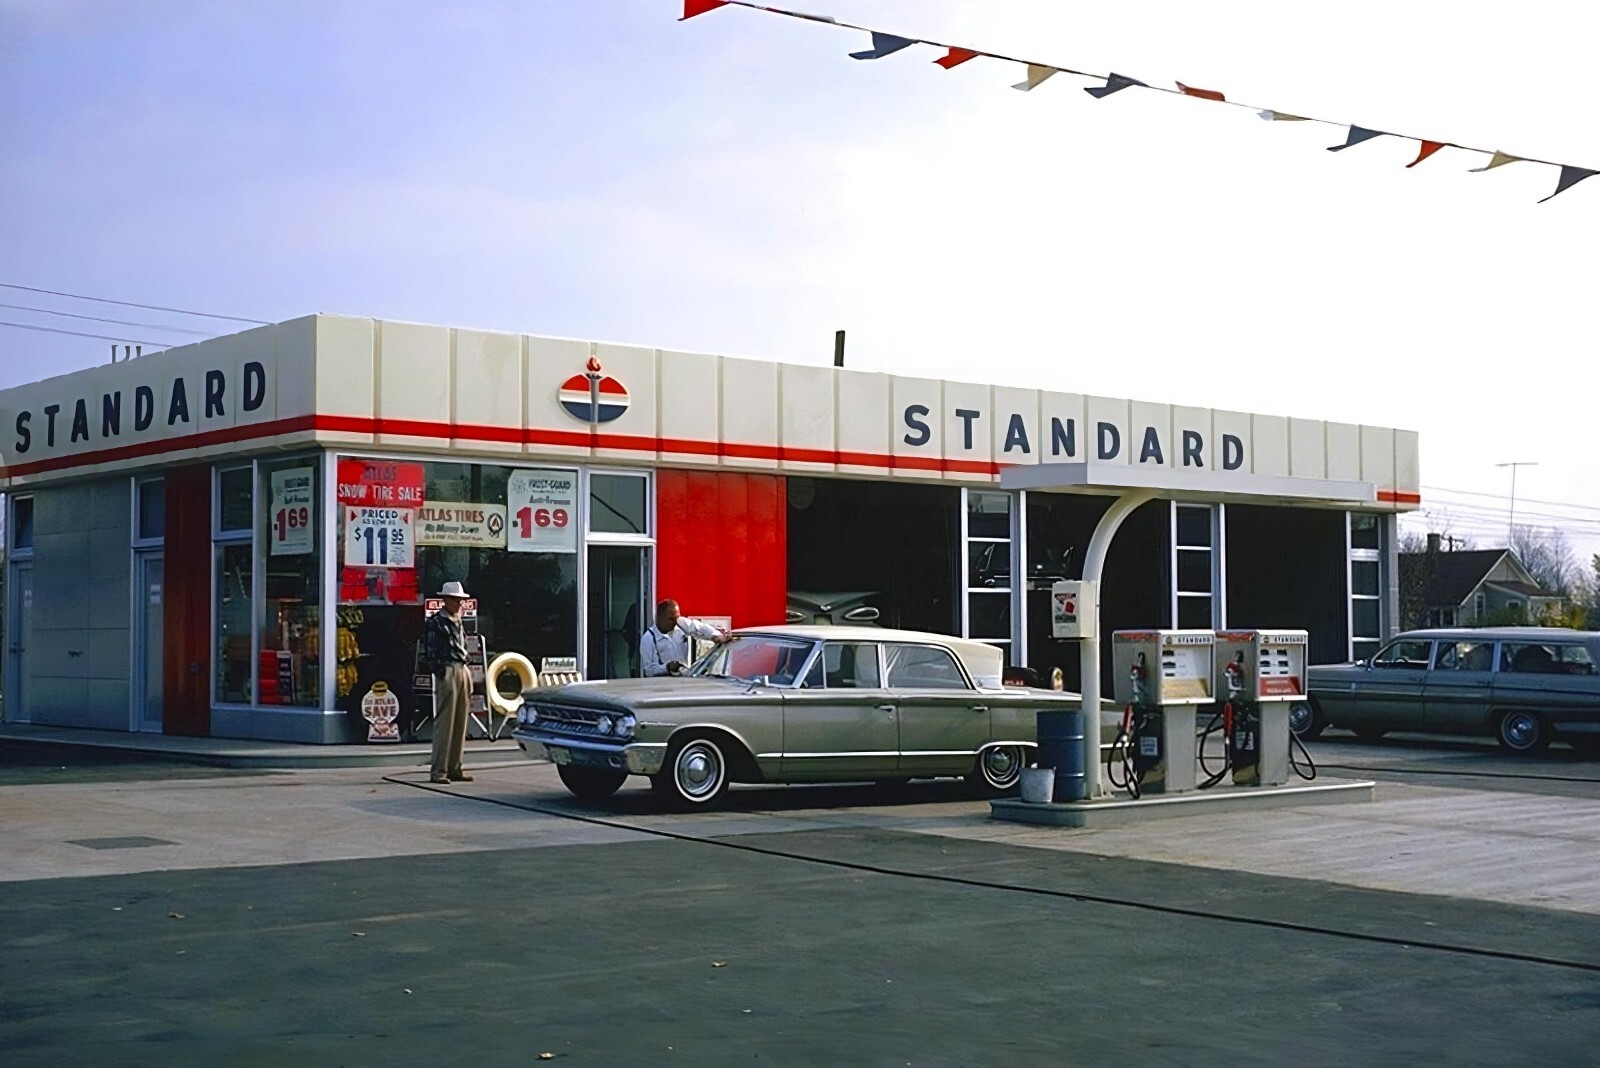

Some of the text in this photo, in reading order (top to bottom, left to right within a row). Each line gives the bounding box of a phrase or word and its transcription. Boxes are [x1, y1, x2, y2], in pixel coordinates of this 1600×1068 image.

[15, 361, 266, 453] STANDARD
[903, 404, 1244, 470] STANDARD
[338, 483, 422, 501] SNOW TIRE SALE
[361, 508, 398, 519] PRICED
[417, 508, 485, 523] ATLAS TIRES
[364, 705, 397, 718] SAVE
